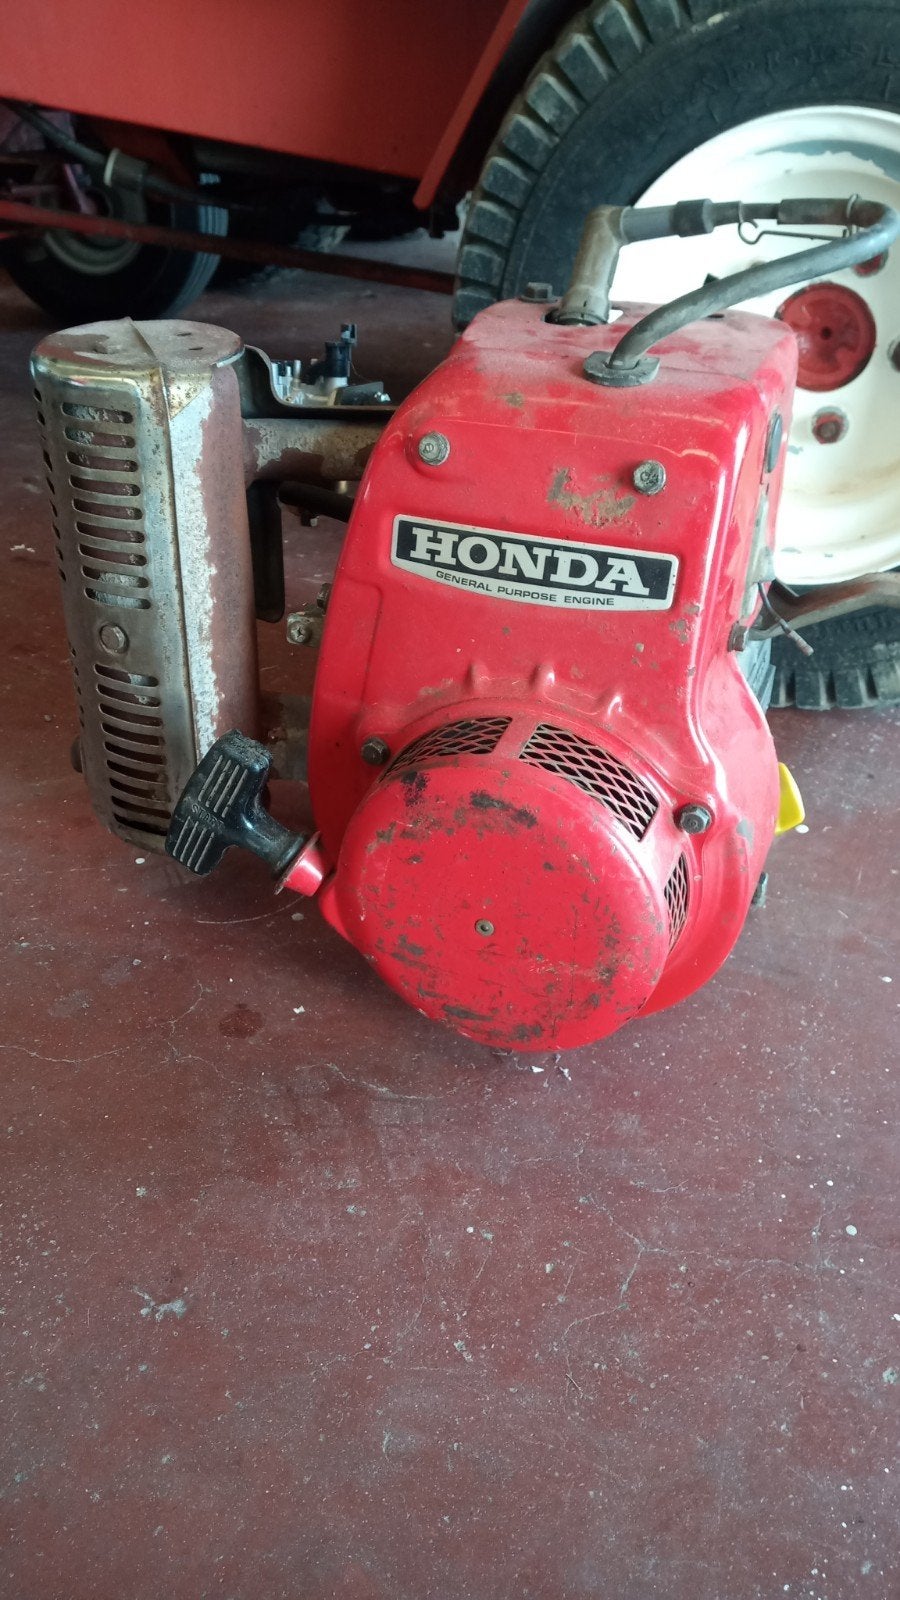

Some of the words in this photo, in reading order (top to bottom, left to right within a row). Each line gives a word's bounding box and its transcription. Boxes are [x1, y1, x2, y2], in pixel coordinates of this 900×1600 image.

[410, 527, 650, 595] HONDA
[436, 570, 492, 592] GENERAL
[497, 586, 557, 602] PURPOSE
[564, 595, 615, 606] ENGINE
